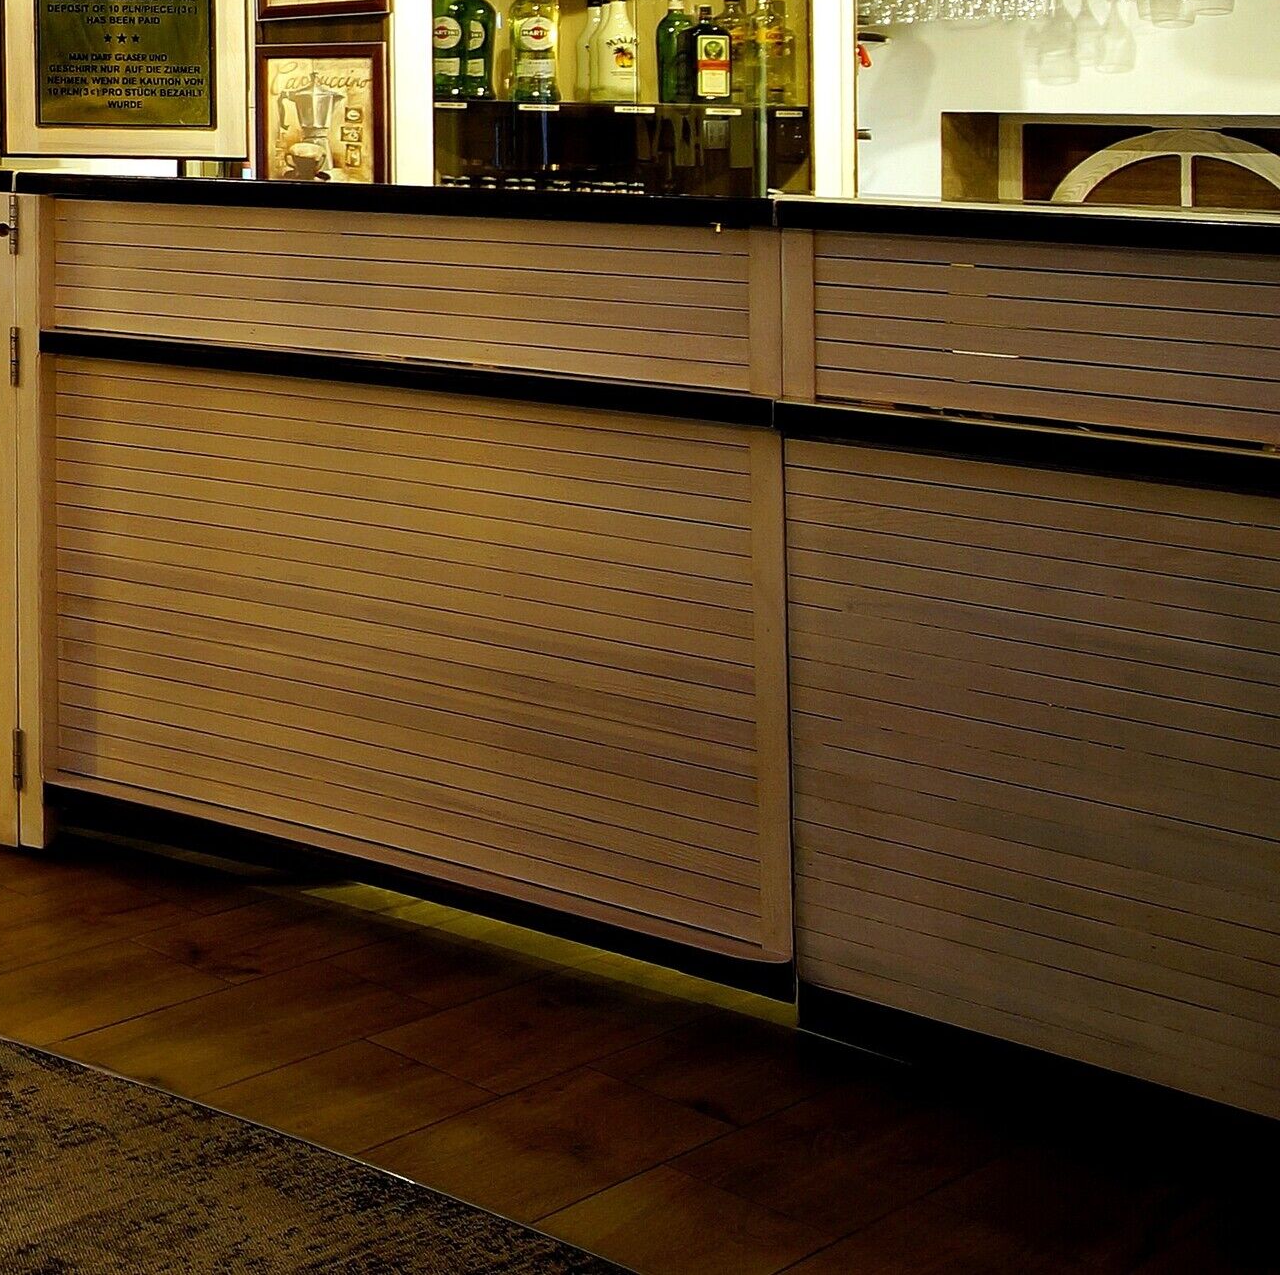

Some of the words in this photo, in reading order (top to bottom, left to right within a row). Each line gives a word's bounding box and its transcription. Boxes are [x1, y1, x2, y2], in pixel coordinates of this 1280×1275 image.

[47, 5, 89, 13] DEPOSIT
[109, 5, 119, 13] 10
[125, 66, 143, 74] AUF
[147, 66, 161, 74] DIE
[164, 66, 200, 74] ZIMMER
[91, 77, 119, 85] WENN
[122, 77, 136, 85] DIE
[139, 77, 181, 85] KAUTION
[184, 77, 204, 85] VON
[102, 88, 122, 96] PRO
[107, 101, 142, 109] WURDE
